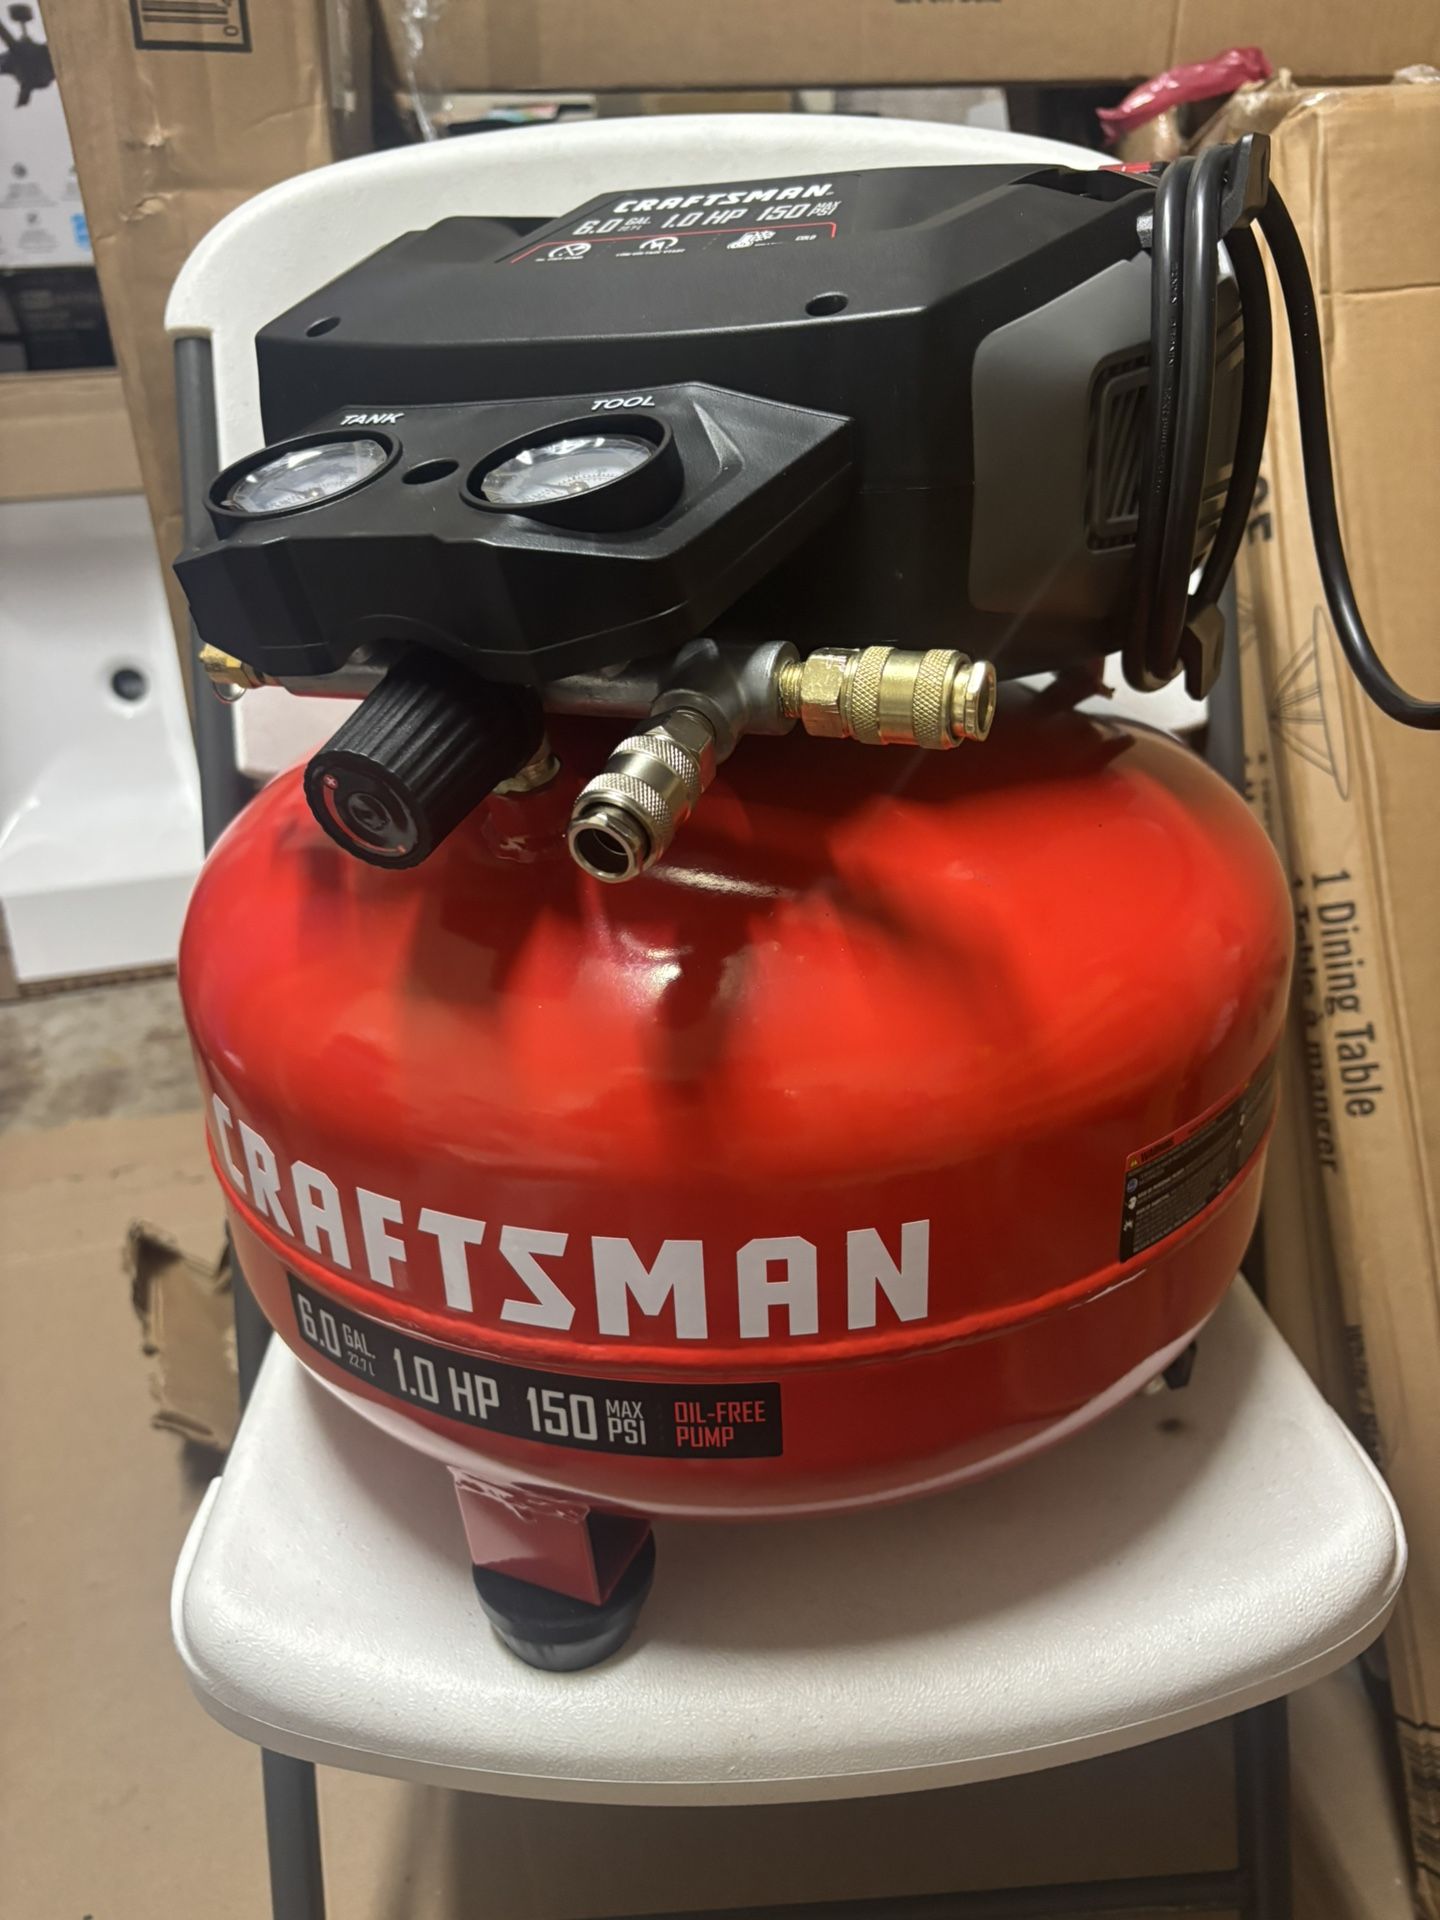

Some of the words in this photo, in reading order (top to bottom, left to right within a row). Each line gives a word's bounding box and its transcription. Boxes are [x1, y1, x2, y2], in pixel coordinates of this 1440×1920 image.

[613, 183, 832, 213] CRAFTSMAN
[661, 212, 704, 229] 1.0
[701, 207, 748, 226] HP
[756, 203, 811, 222] 150
[806, 207, 837, 218] PSI
[572, 218, 624, 236] 6.0
[590, 396, 656, 411] TOOL
[340, 412, 404, 426] TANK
[1312, 868, 1351, 889] 1
[1317, 902, 1365, 1018] Dining
[1334, 1022, 1384, 1119] Table
[213, 1093, 929, 1339] CRAFTSMAN
[297, 1293, 342, 1358] 6.0
[342, 1322, 376, 1359] GAL.
[394, 1348, 440, 1404] 1.0
[448, 1366, 500, 1419] HP
[526, 1386, 598, 1441] 150
[605, 1398, 643, 1420] MAX
[674, 1400, 767, 1424] OIL-FREE
[609, 1417, 647, 1445] PSI
[676, 1426, 734, 1447] PUMP
